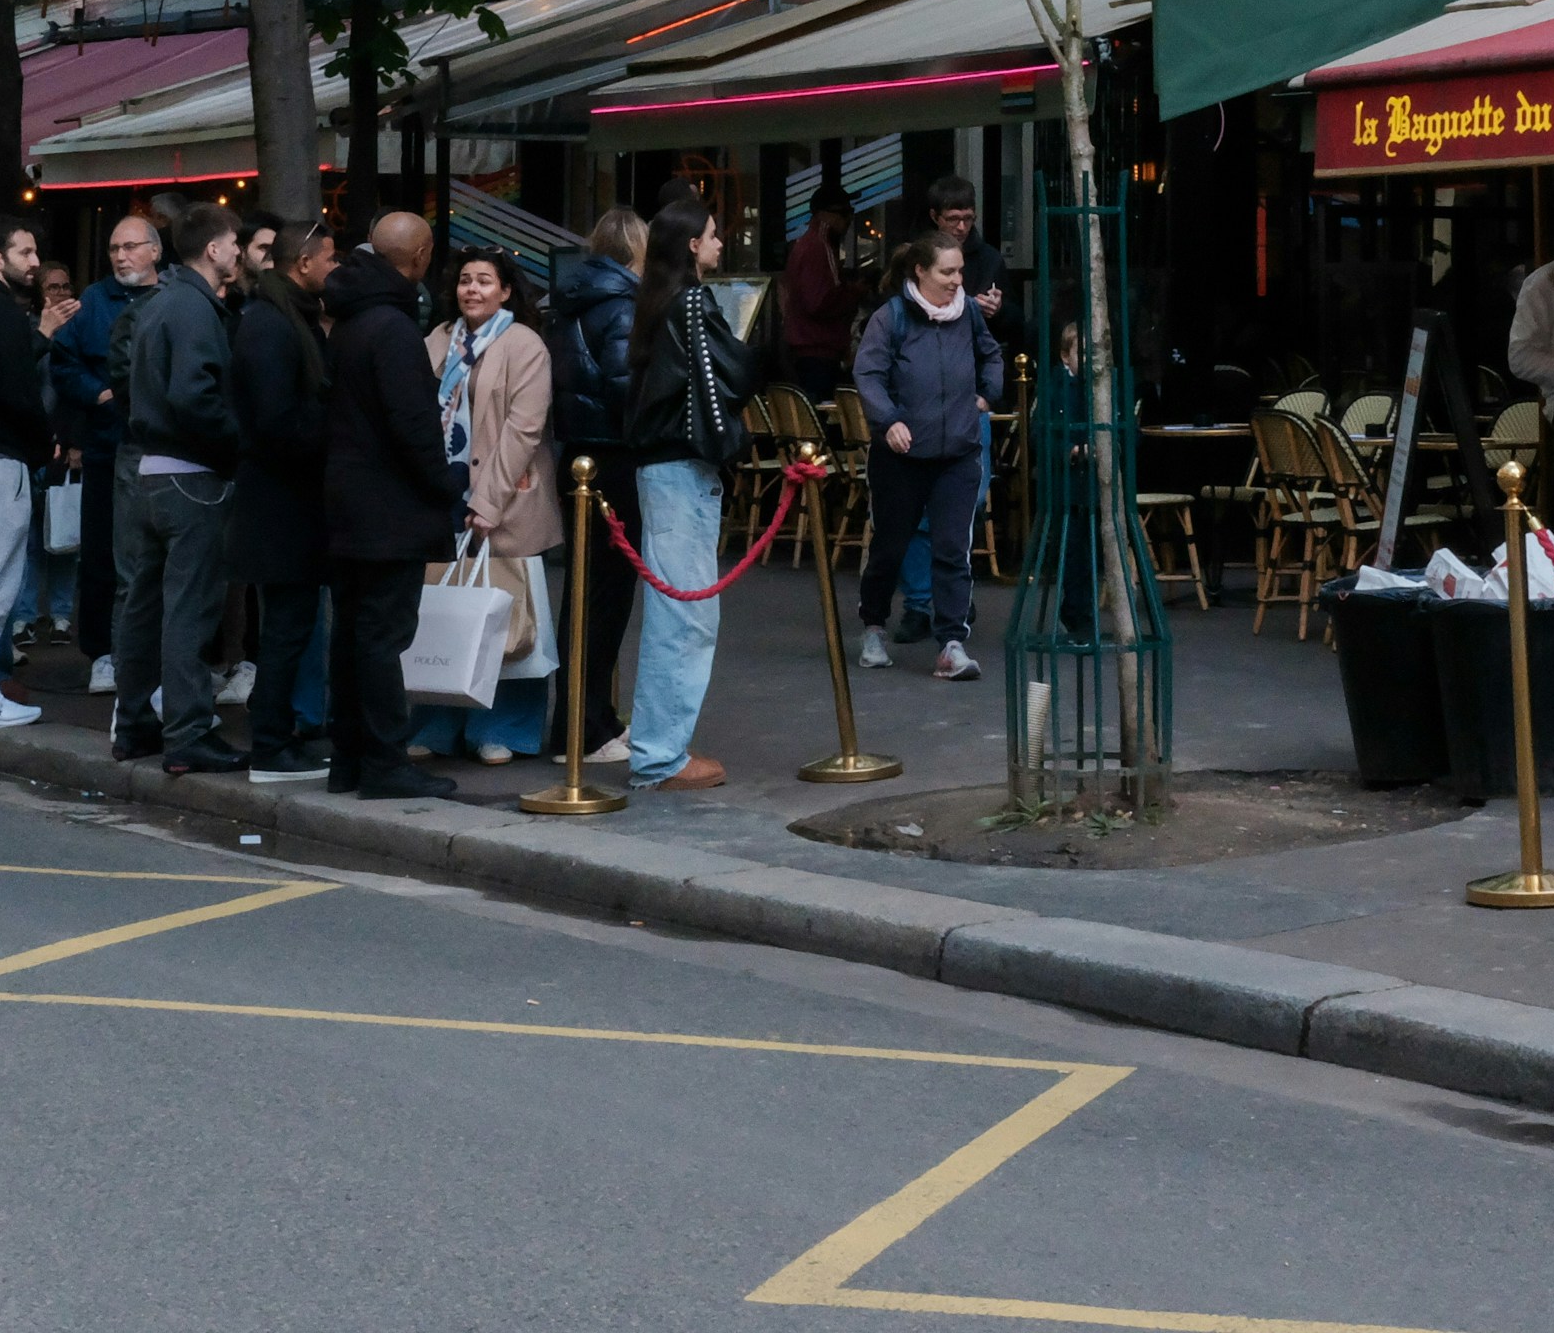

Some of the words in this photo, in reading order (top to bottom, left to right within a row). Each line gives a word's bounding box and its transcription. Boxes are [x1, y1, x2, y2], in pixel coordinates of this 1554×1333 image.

[1353, 101, 1378, 146] la
[1385, 94, 1506, 158] Baguette
[1514, 90, 1552, 134] du
